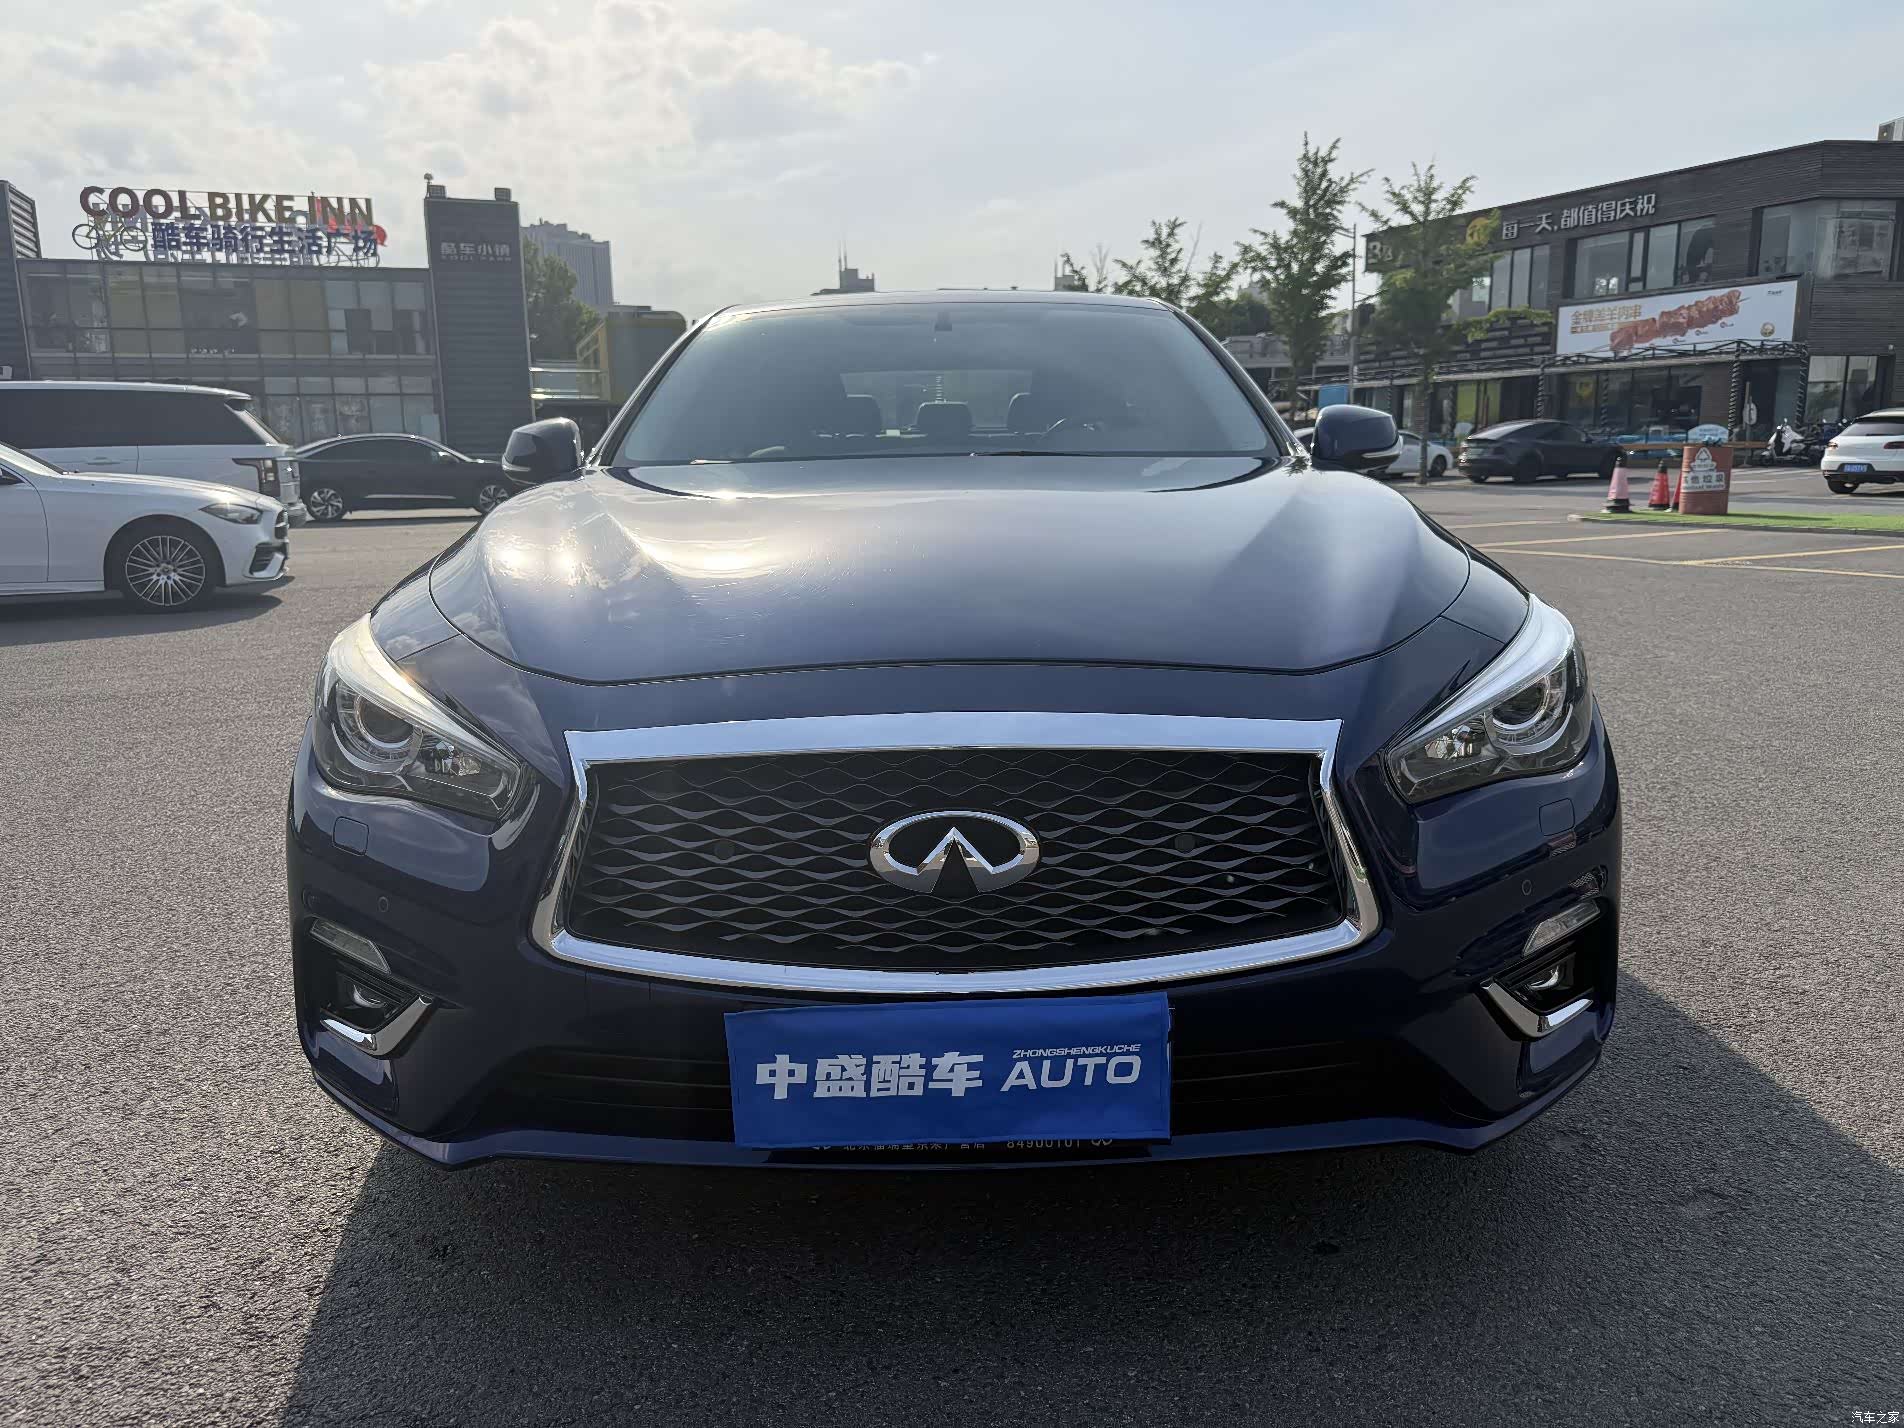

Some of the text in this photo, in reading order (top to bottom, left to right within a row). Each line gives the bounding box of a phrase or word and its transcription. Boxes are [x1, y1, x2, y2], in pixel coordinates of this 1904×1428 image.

[79, 185, 374, 227] COOL BIKE INN
[1013, 1044, 1141, 1058] ZHONGSHENGKUCHE
[756, 1052, 1142, 1099] 中盛酷车 AUTO
